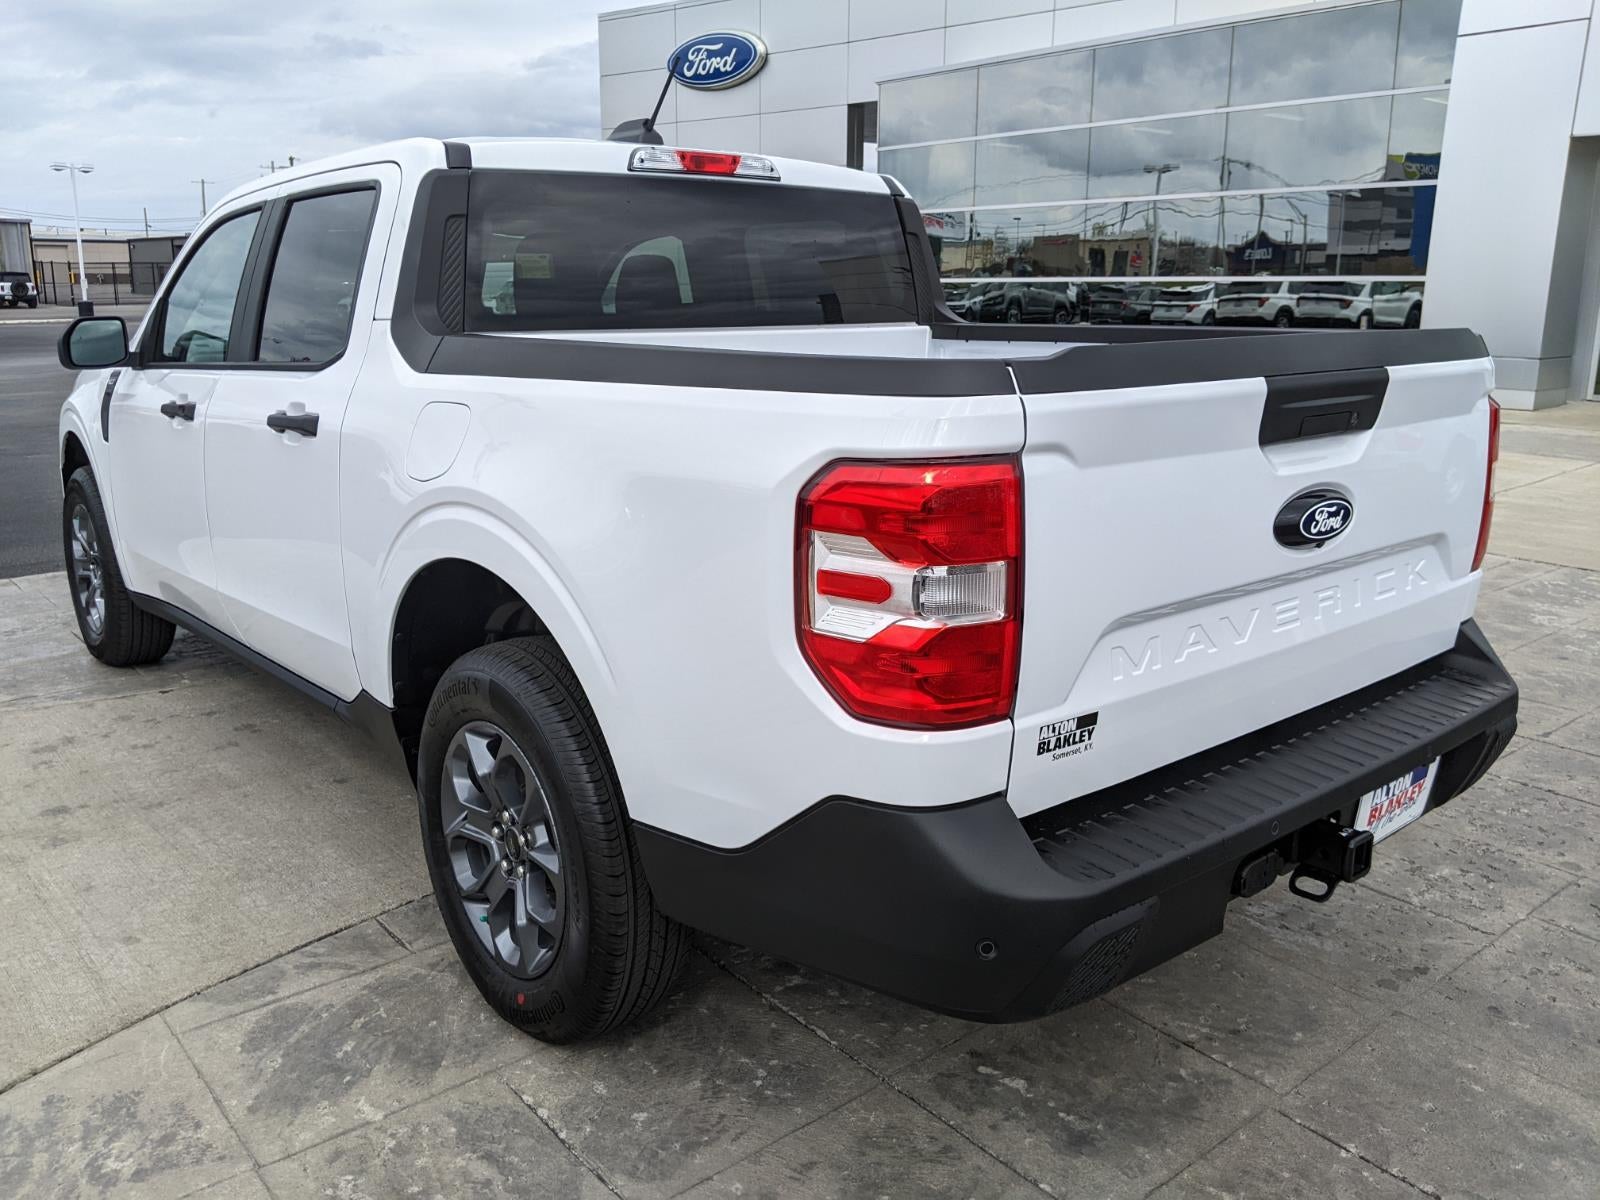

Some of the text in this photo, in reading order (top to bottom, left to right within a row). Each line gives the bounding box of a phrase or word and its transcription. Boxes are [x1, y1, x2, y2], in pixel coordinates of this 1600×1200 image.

[683, 43, 737, 78] Ford
[1310, 505, 1344, 534] Ford
[1110, 558, 1429, 682] MAVERICK
[426, 676, 471, 728] Continental
[1036, 726, 1096, 756] BLAKLEY
[1039, 718, 1078, 741] ALTON
[1366, 780, 1426, 828] BLAKLEY
[1371, 771, 1414, 806] ALTON
